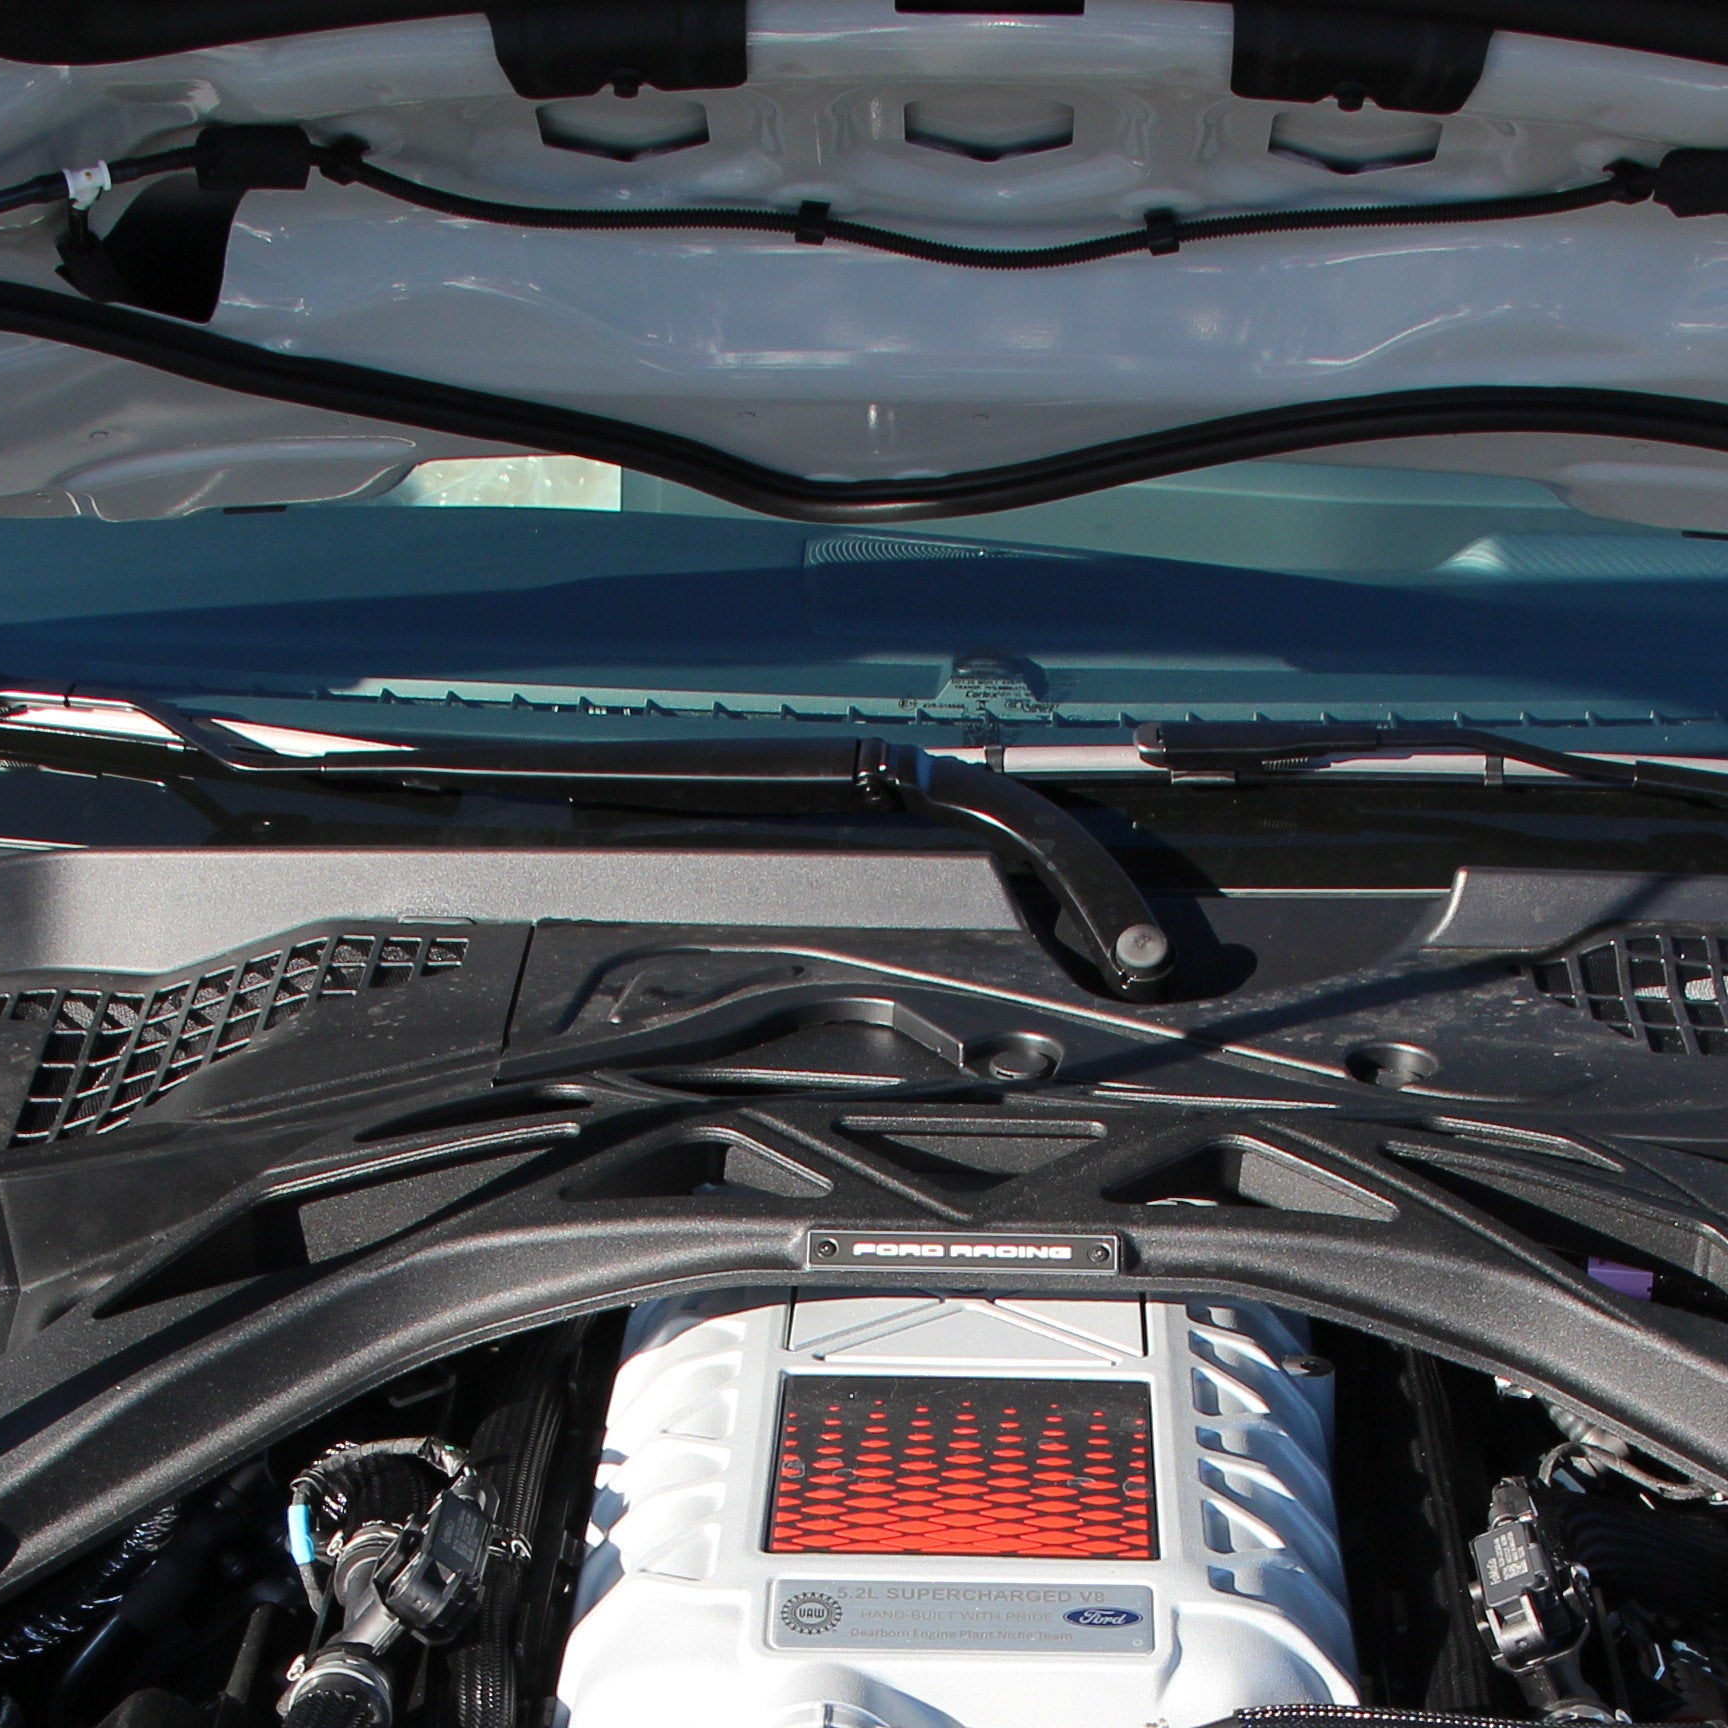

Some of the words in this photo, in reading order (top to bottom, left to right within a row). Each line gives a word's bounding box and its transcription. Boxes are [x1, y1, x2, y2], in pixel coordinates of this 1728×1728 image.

[852, 1243, 944, 1259] FORD
[950, 1243, 1073, 1260] RACING
[836, 1587, 879, 1602] 5.2L
[885, 1587, 1073, 1605] SUPERCHARGED
[1078, 1589, 1105, 1605] V8
[798, 1605, 826, 1622] UAW
[859, 1608, 956, 1623] HAND-BUILT
[959, 1609, 1003, 1623] WITH
[1005, 1610, 1053, 1623] PRIDE
[1077, 1608, 1129, 1627] Ford
[850, 1627, 910, 1640] Dearborn
[912, 1628, 957, 1642] Engine
[958, 1628, 994, 1641] Plant
[996, 1629, 1033, 1642] Niche
[1036, 1630, 1074, 1642] Team
